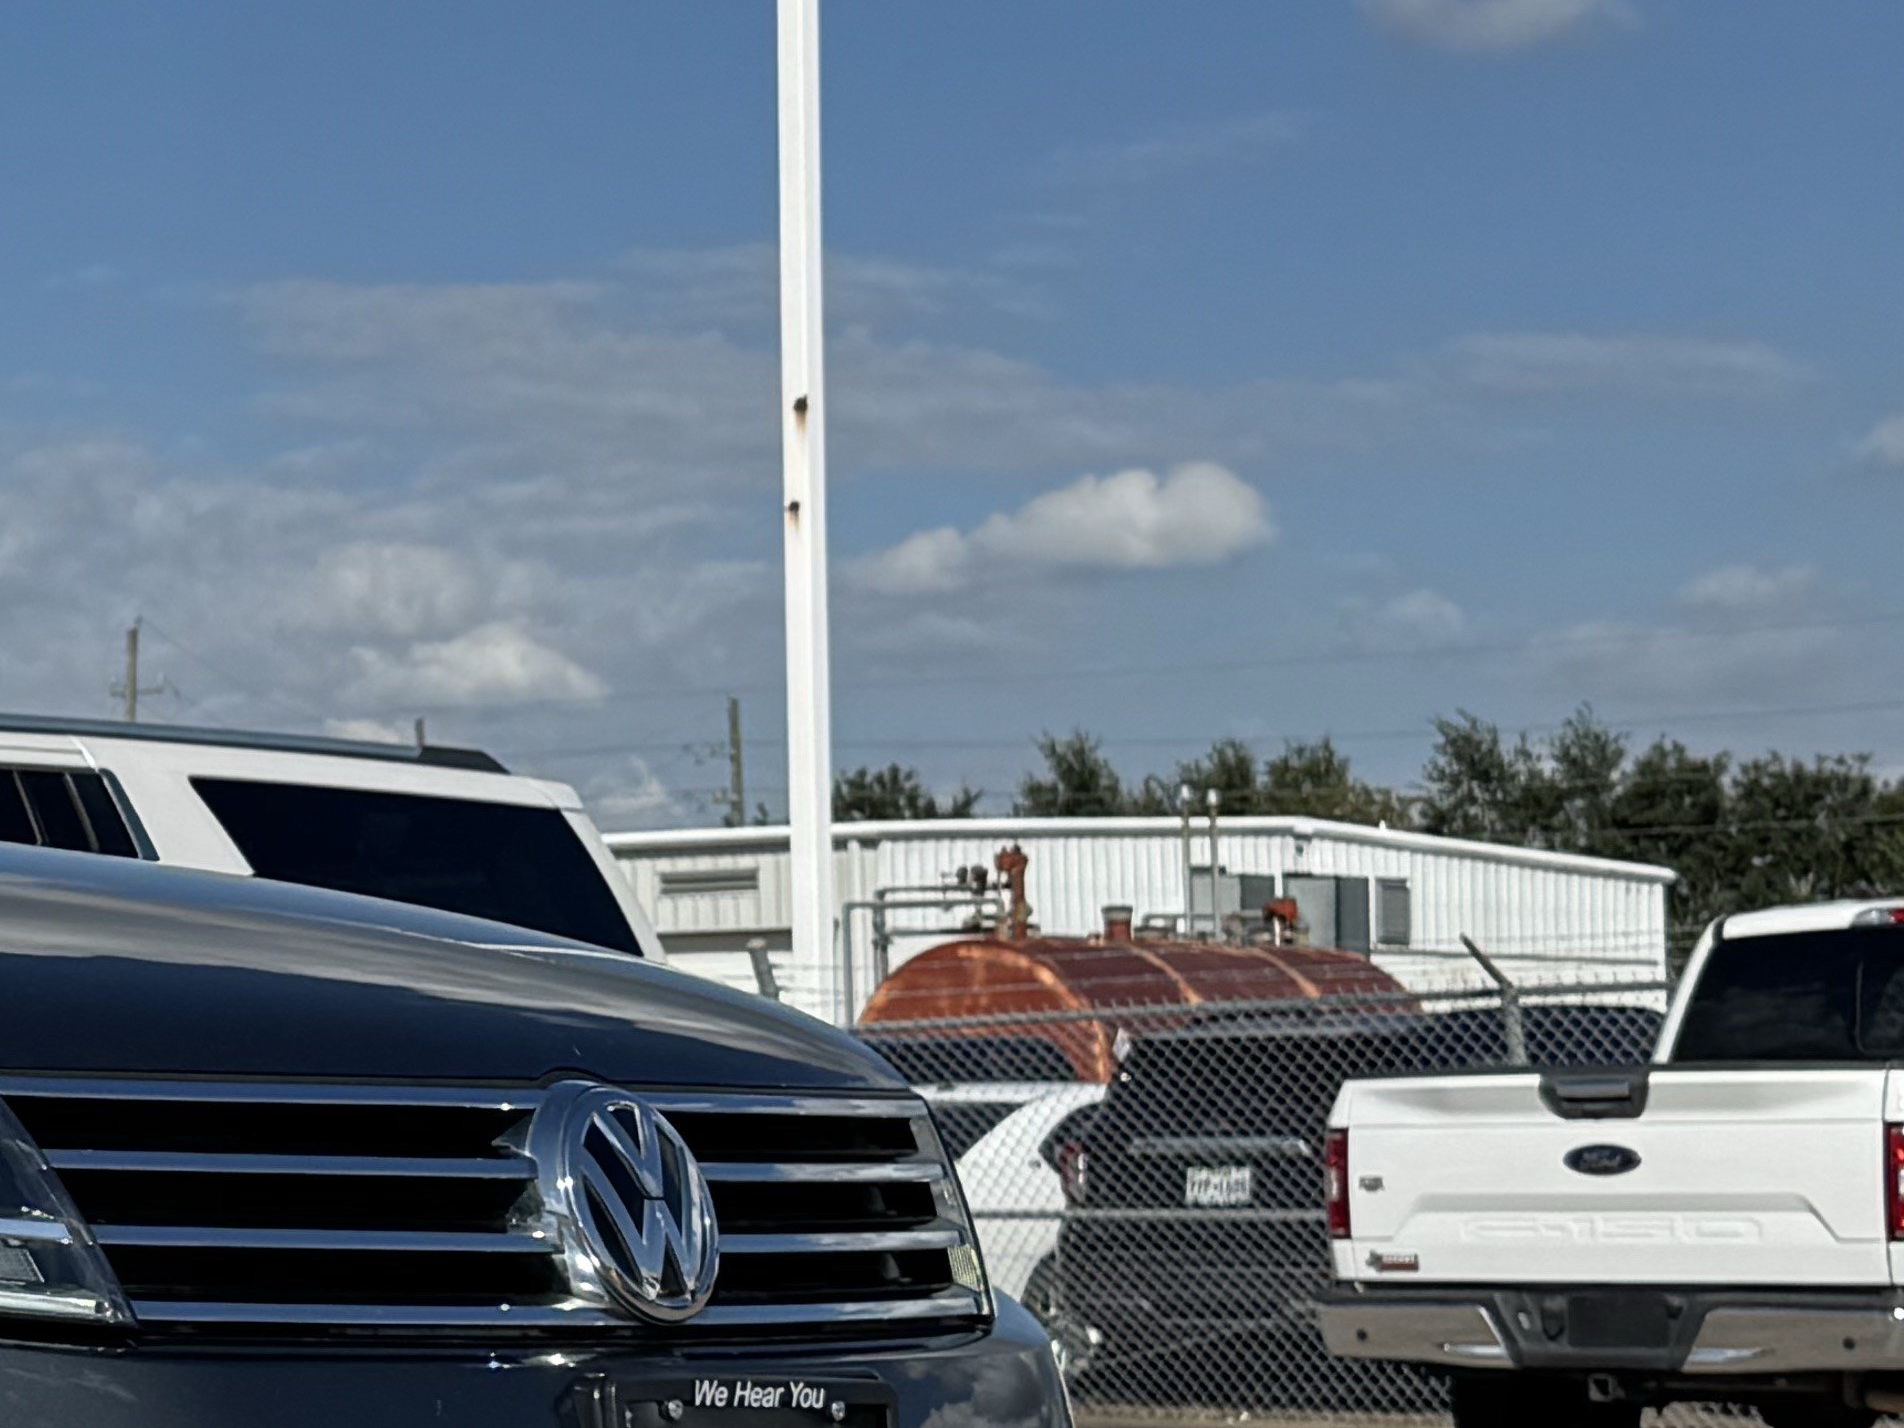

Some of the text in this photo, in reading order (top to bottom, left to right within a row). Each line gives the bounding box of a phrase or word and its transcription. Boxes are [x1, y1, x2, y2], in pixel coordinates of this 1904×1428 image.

[694, 1380, 825, 1409] We Hear You
